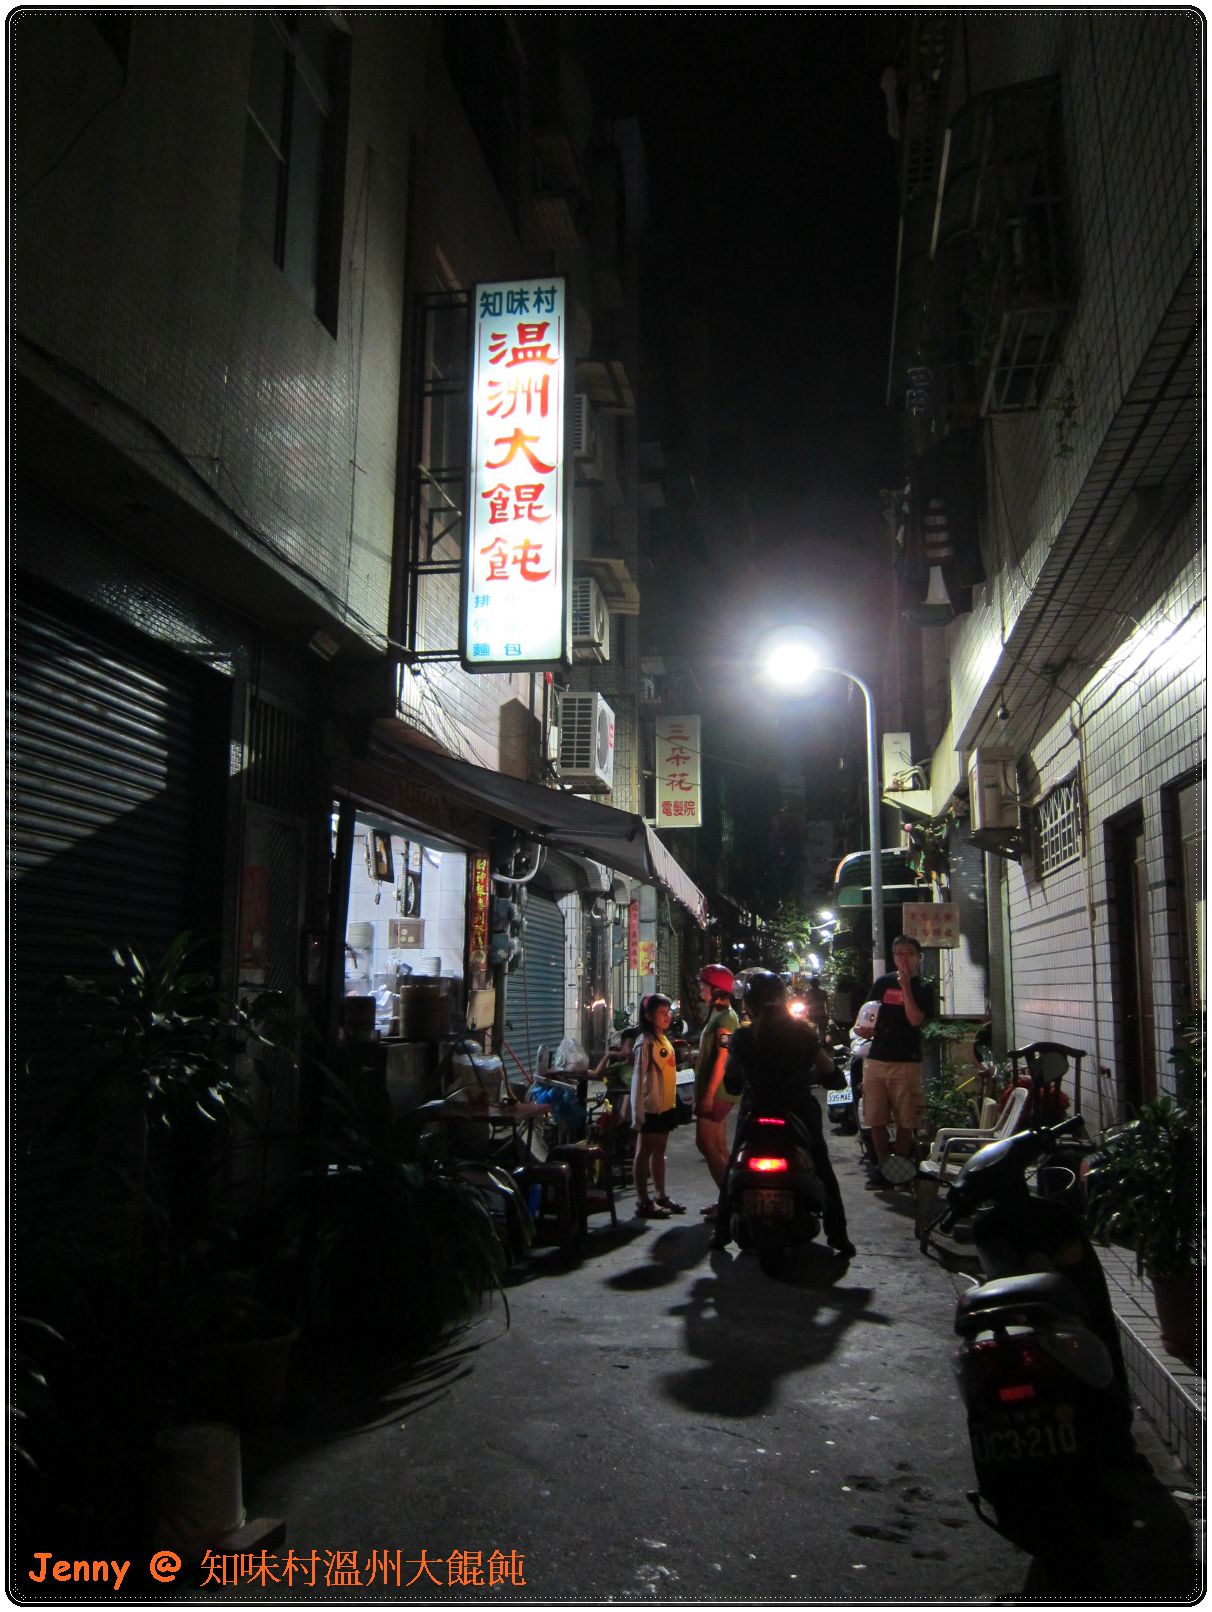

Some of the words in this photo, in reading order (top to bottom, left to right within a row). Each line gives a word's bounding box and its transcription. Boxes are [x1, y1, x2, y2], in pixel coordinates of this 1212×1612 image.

[480, 286, 558, 319] 知味村
[664, 724, 693, 791] 三朵花
[662, 800, 695, 817] 電髮院
